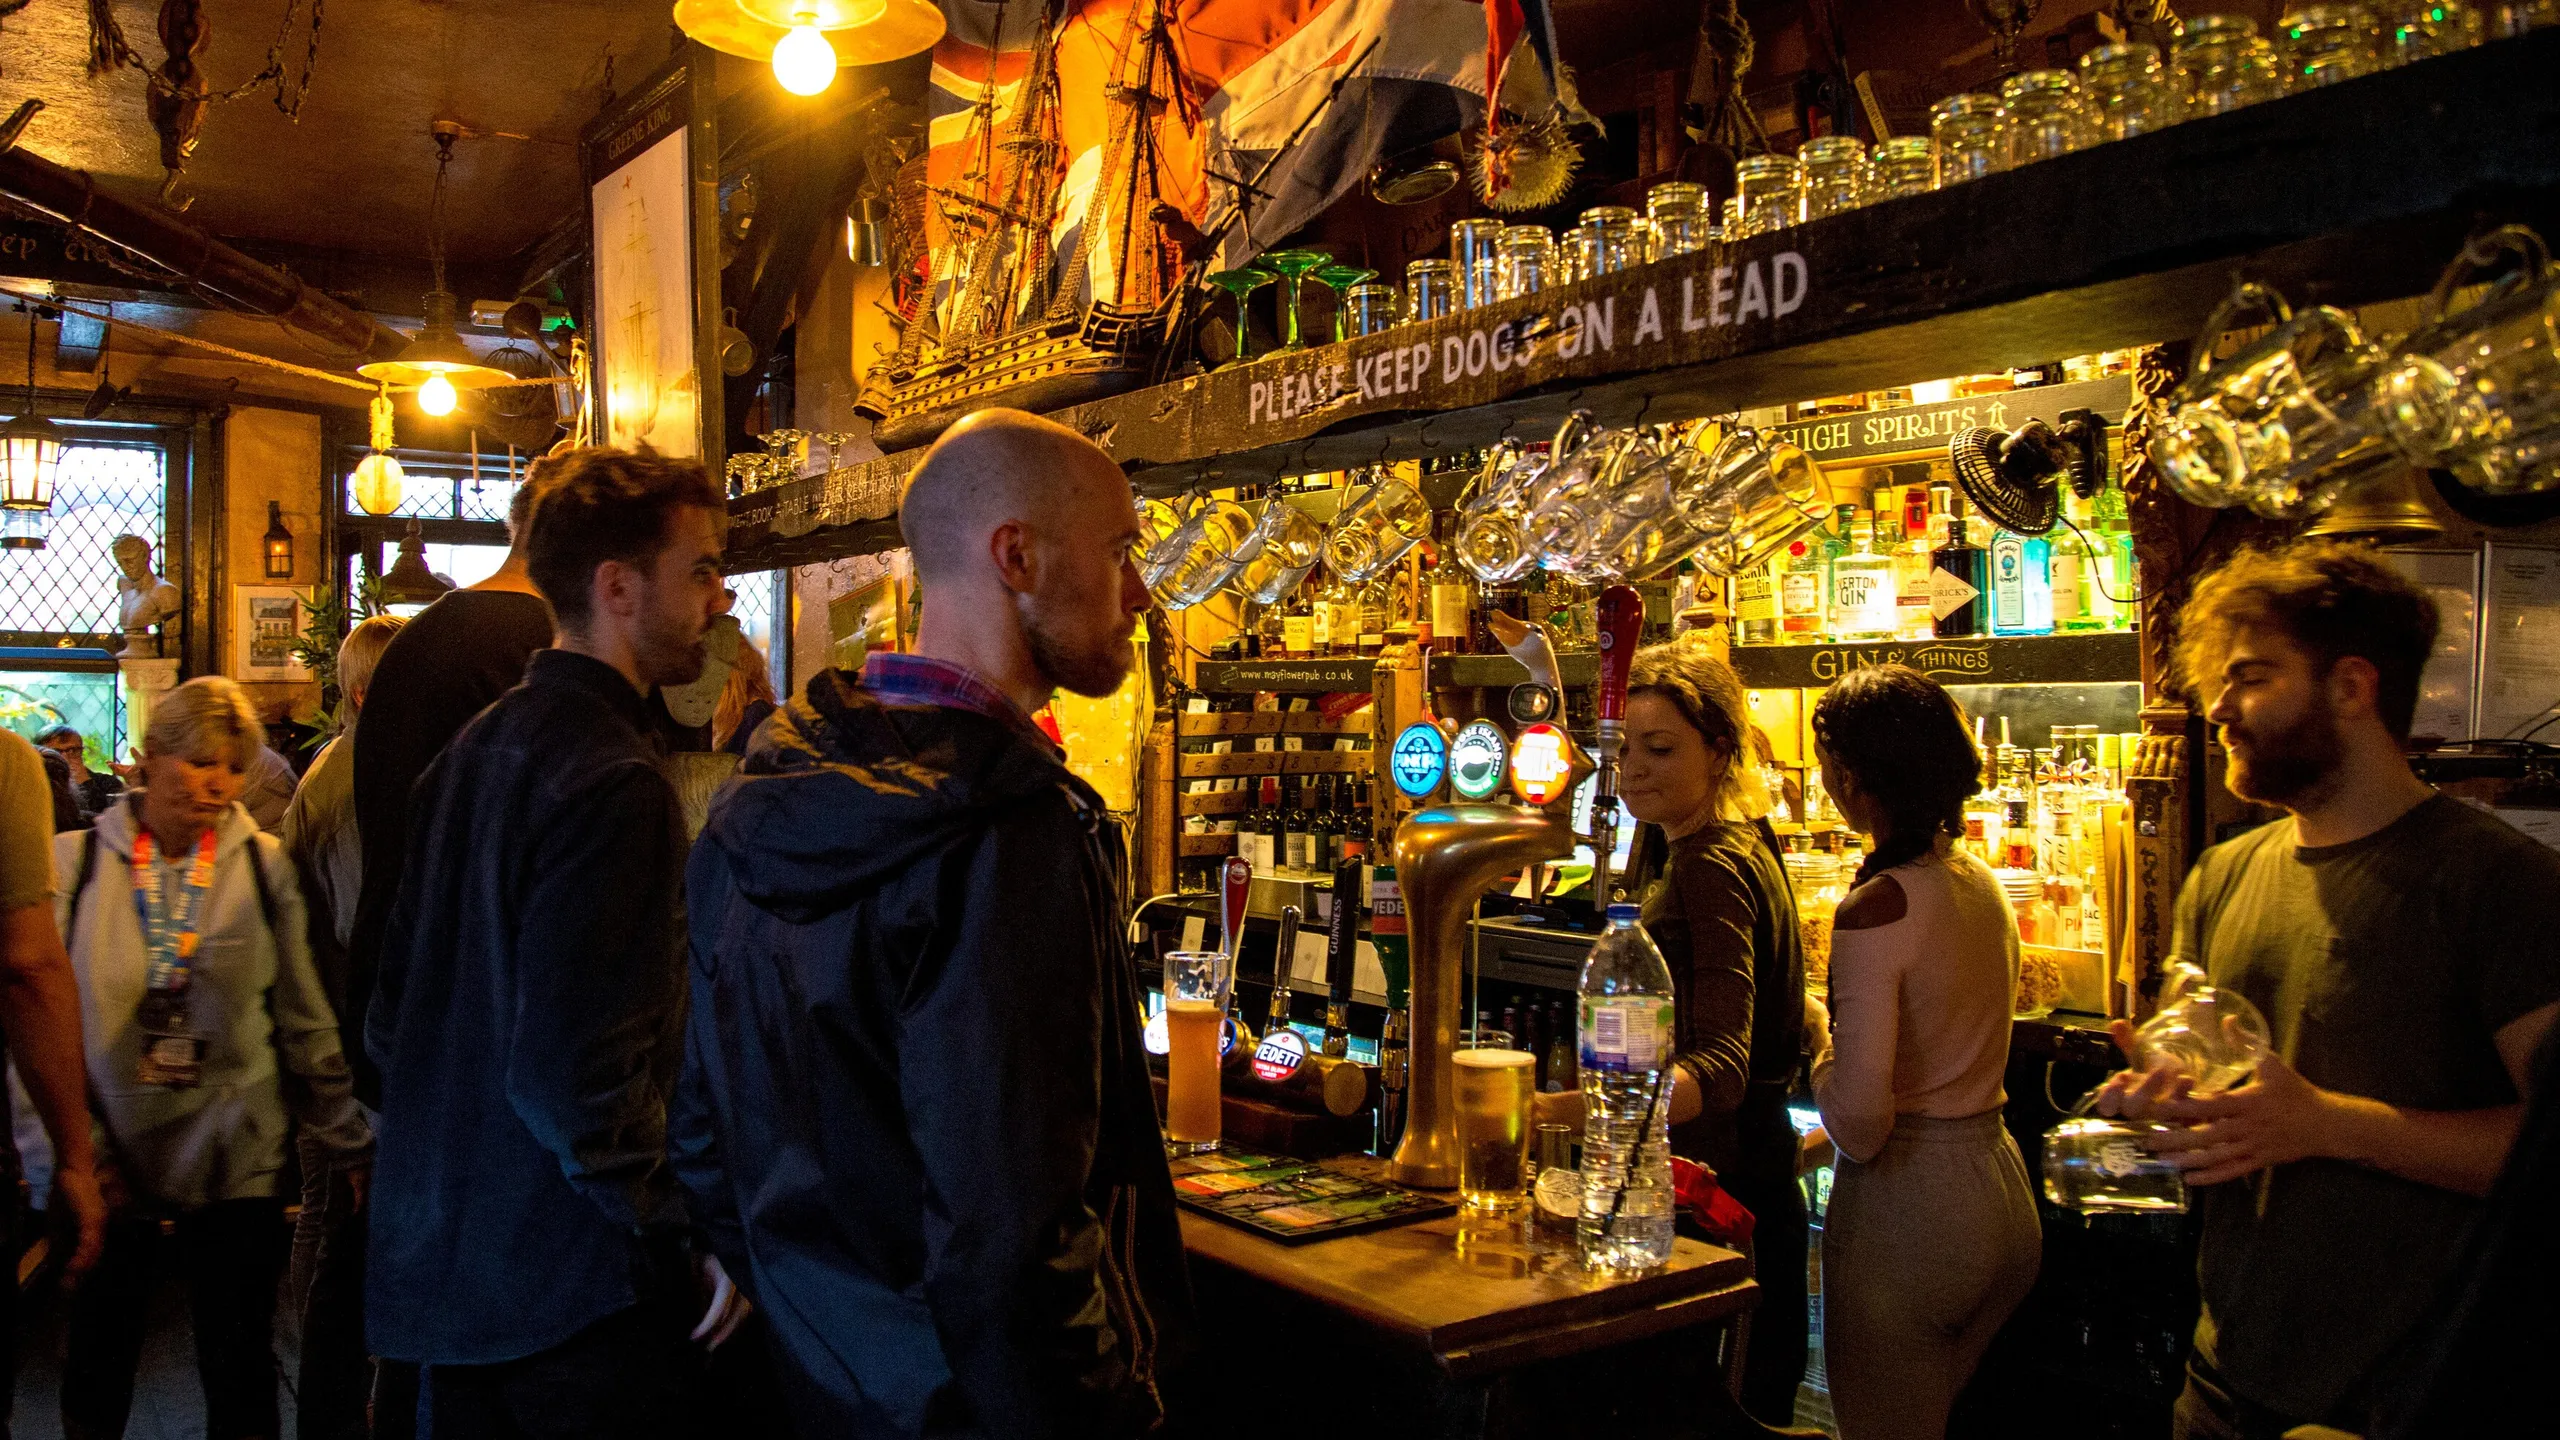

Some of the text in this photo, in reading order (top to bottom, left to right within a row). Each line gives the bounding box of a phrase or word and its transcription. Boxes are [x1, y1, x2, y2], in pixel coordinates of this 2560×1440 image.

[608, 101, 671, 160] GREENE KING
[1249, 251, 1809, 425] PLEASE KEEP DOGS ON A LEAD
[1780, 406, 1976, 452] HIGH SPIRITS
[751, 505, 774, 526] BOOK
[783, 494, 809, 518] TABLE
[1756, 578, 1771, 594] Gin
[1840, 586, 1867, 606] GIN
[1811, 649, 1880, 680] GIN
[1918, 651, 1989, 669] THINGS
[1220, 718, 1229, 730] 2
[1245, 717, 1252, 730] 3
[1478, 726, 1502, 761] ISLAND
[1194, 761, 1204, 773] 5
[1221, 759, 1230, 772] 6
[1266, 759, 1275, 770] 8
[1395, 752, 1421, 768] PUNK
[1192, 798, 1201, 812] 9
[1329, 898, 1342, 955] GUINNESS
[1255, 1043, 1302, 1068] VEDETT
